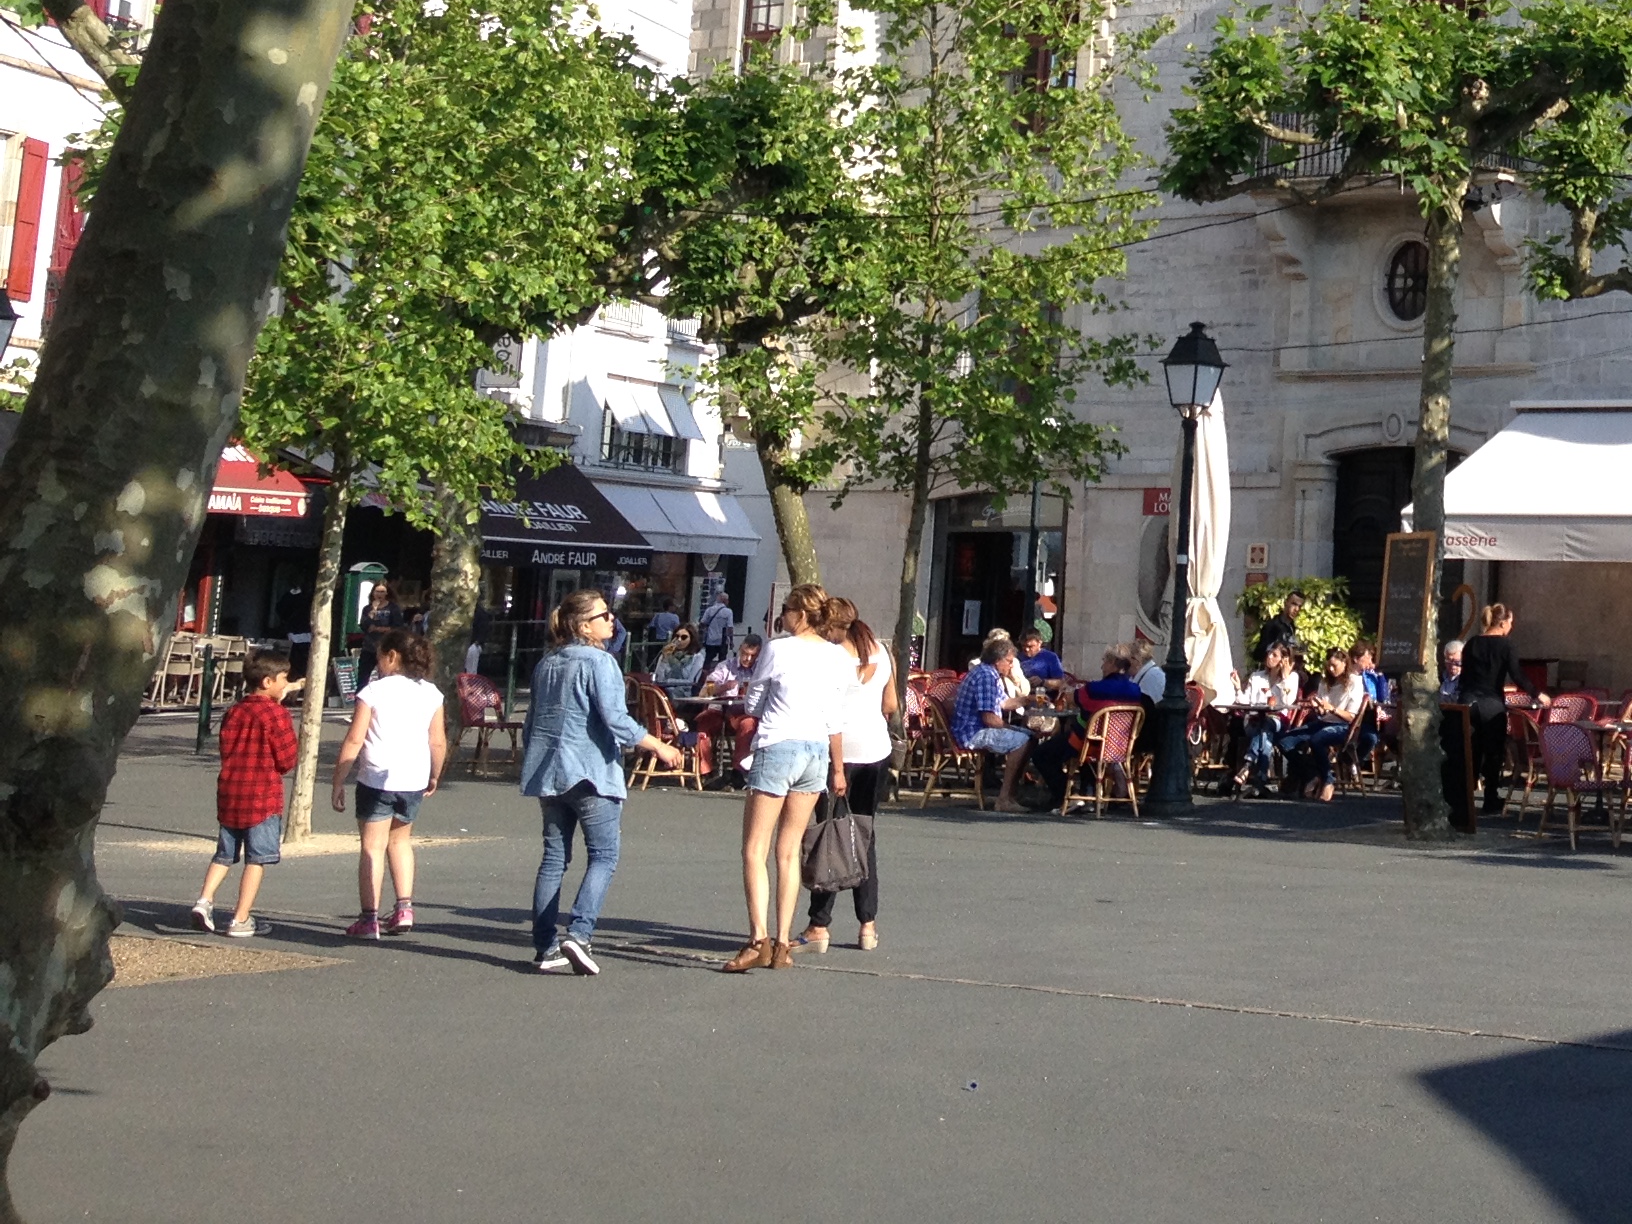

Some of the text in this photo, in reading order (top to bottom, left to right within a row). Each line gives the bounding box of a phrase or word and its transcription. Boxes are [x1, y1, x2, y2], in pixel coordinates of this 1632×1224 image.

[533, 501, 589, 520] FAUR
[529, 521, 577, 533] OAILLIER
[1445, 532, 1497, 547] asserie
[481, 549, 509, 559] AILLIER
[531, 549, 566, 565] ANDRÉ
[568, 551, 597, 566] FAUR
